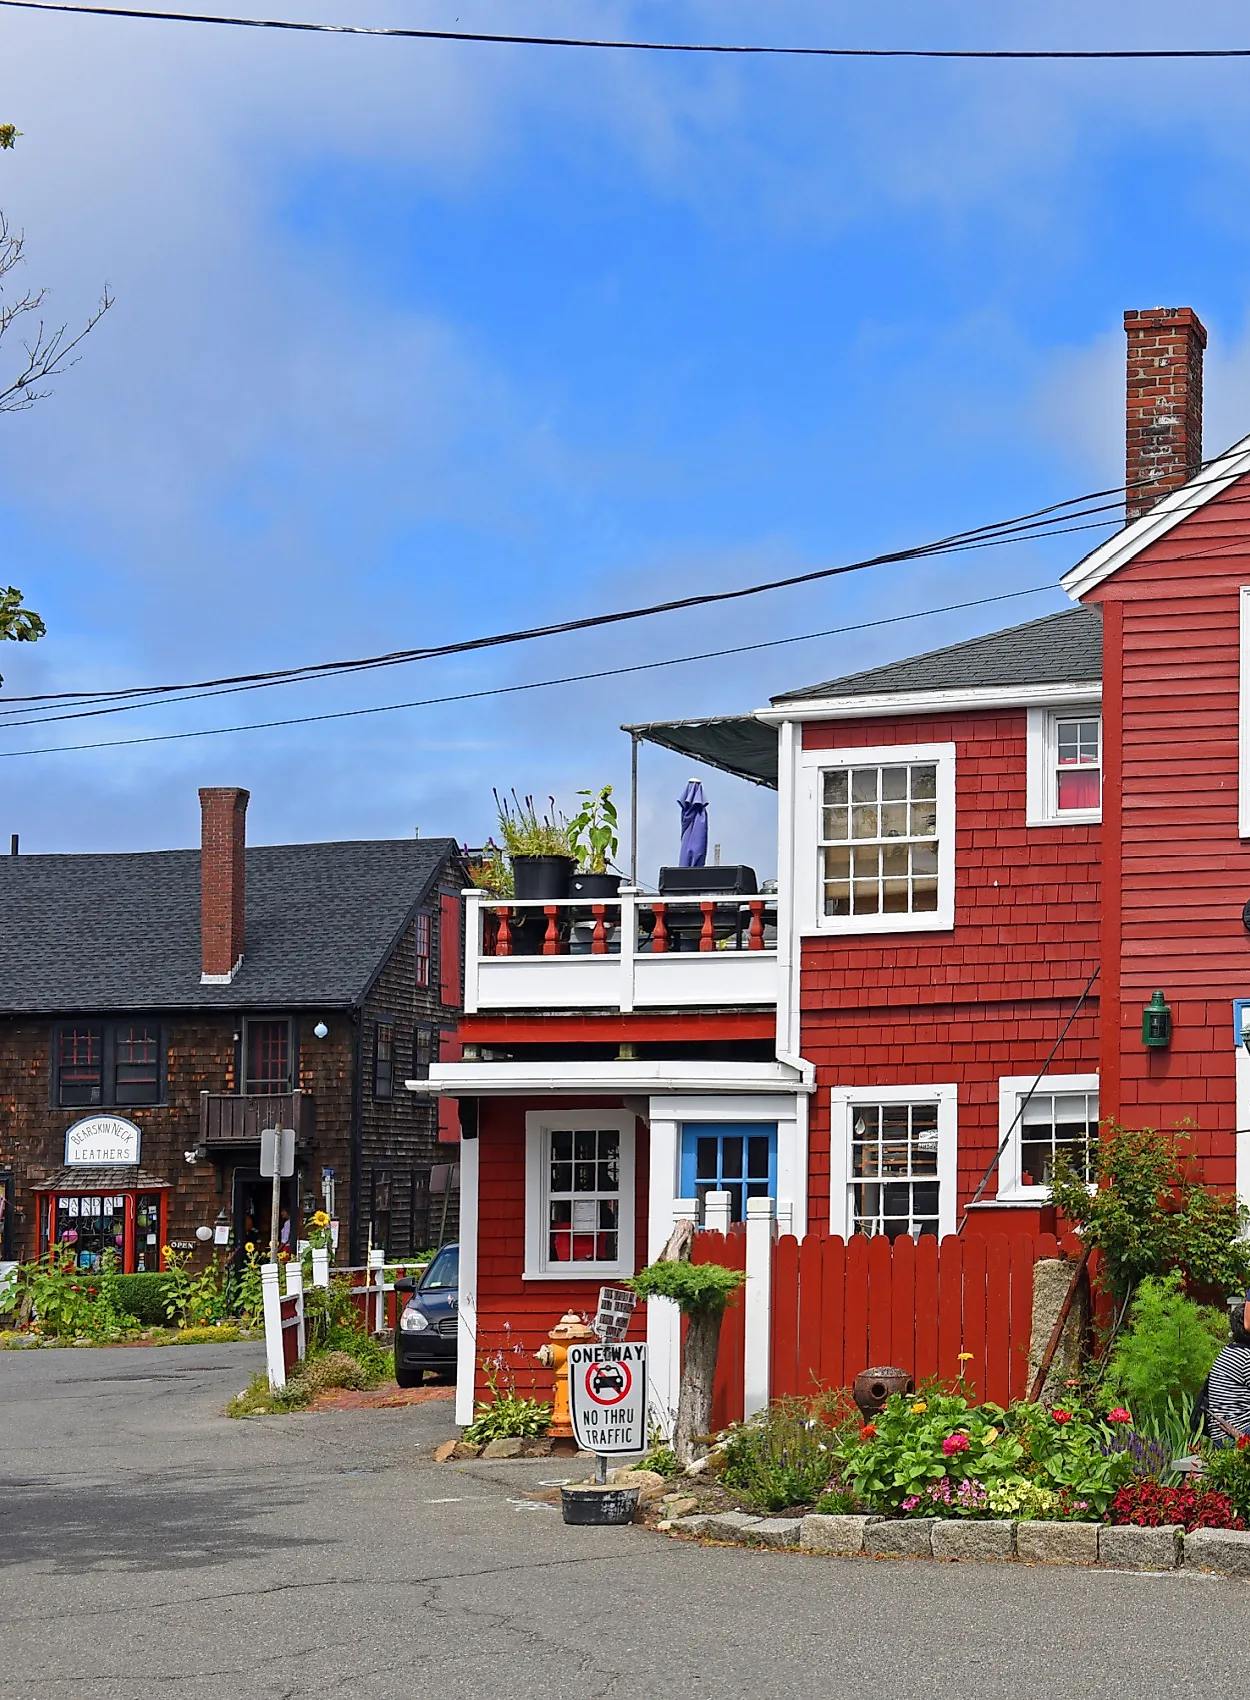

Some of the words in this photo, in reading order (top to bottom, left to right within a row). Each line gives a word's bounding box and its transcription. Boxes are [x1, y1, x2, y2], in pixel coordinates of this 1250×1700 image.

[70, 1123, 111, 1146] BEARSKIN
[112, 1122, 134, 1144] NECK
[75, 1149, 130, 1160] LEATHERS
[170, 1241, 194, 1249] OPEN
[571, 1347, 605, 1364] ONE
[610, 1345, 644, 1362] WAY
[583, 1410, 598, 1425] NO
[604, 1408, 634, 1425] THRU
[586, 1427, 632, 1444] TRAFFIC
